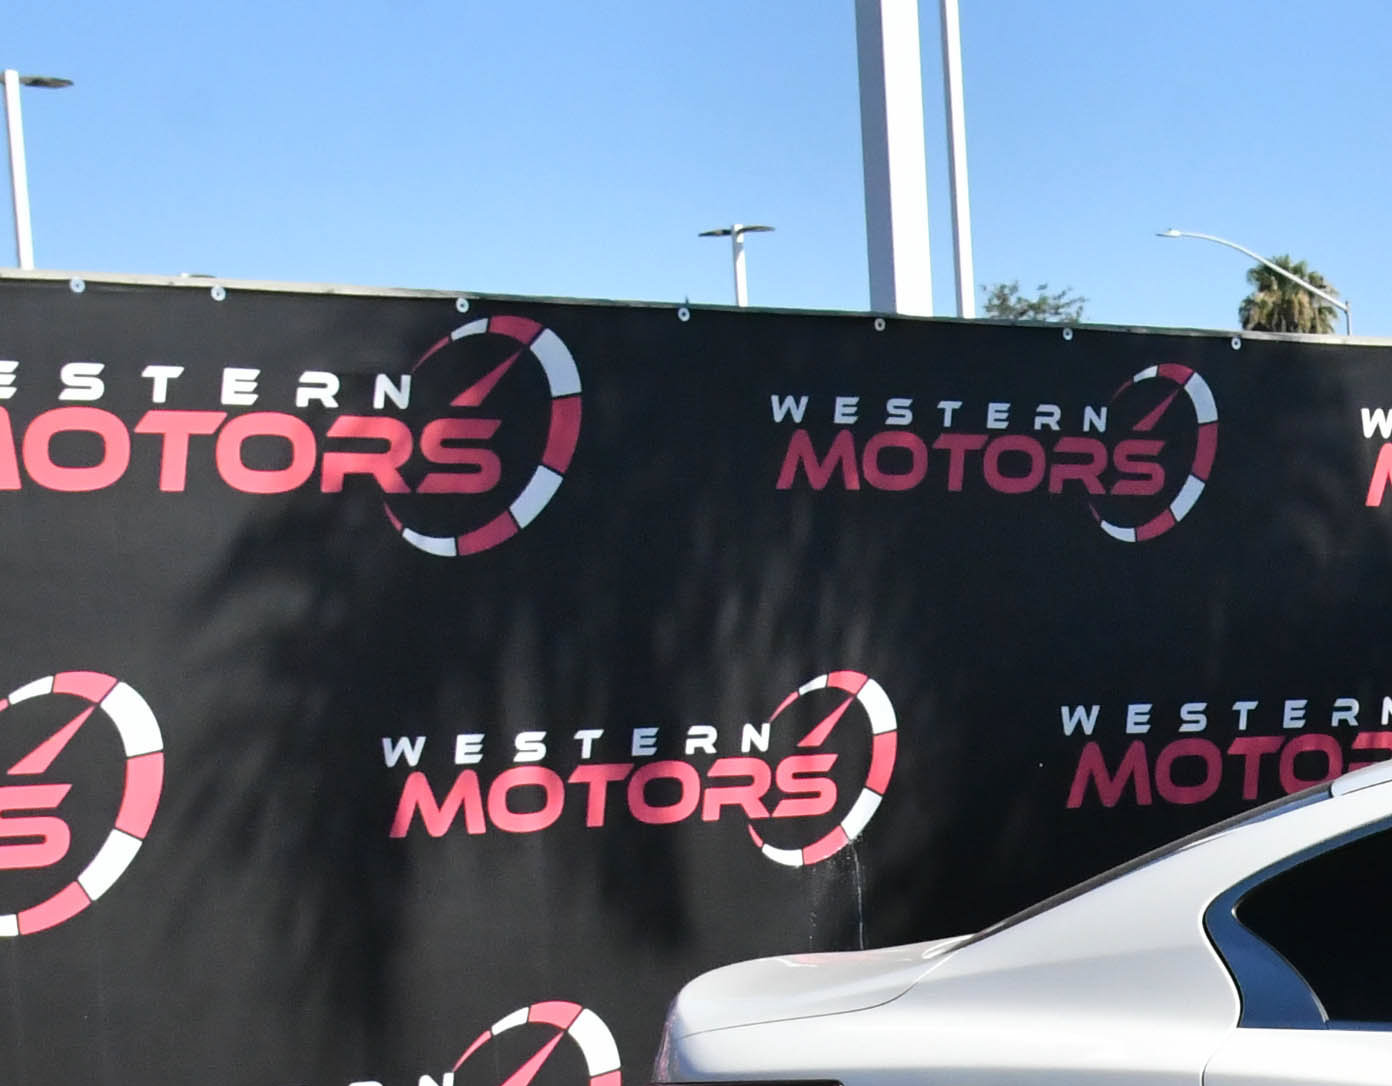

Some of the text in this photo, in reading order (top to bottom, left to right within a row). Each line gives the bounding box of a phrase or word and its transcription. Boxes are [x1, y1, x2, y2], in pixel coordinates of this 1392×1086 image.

[771, 395, 1108, 432] WESTERN
[0, 405, 501, 494] OTORS
[777, 429, 1166, 495] MOTORS
[382, 722, 771, 768] WESTERN
[389, 754, 839, 839] MOTORS
